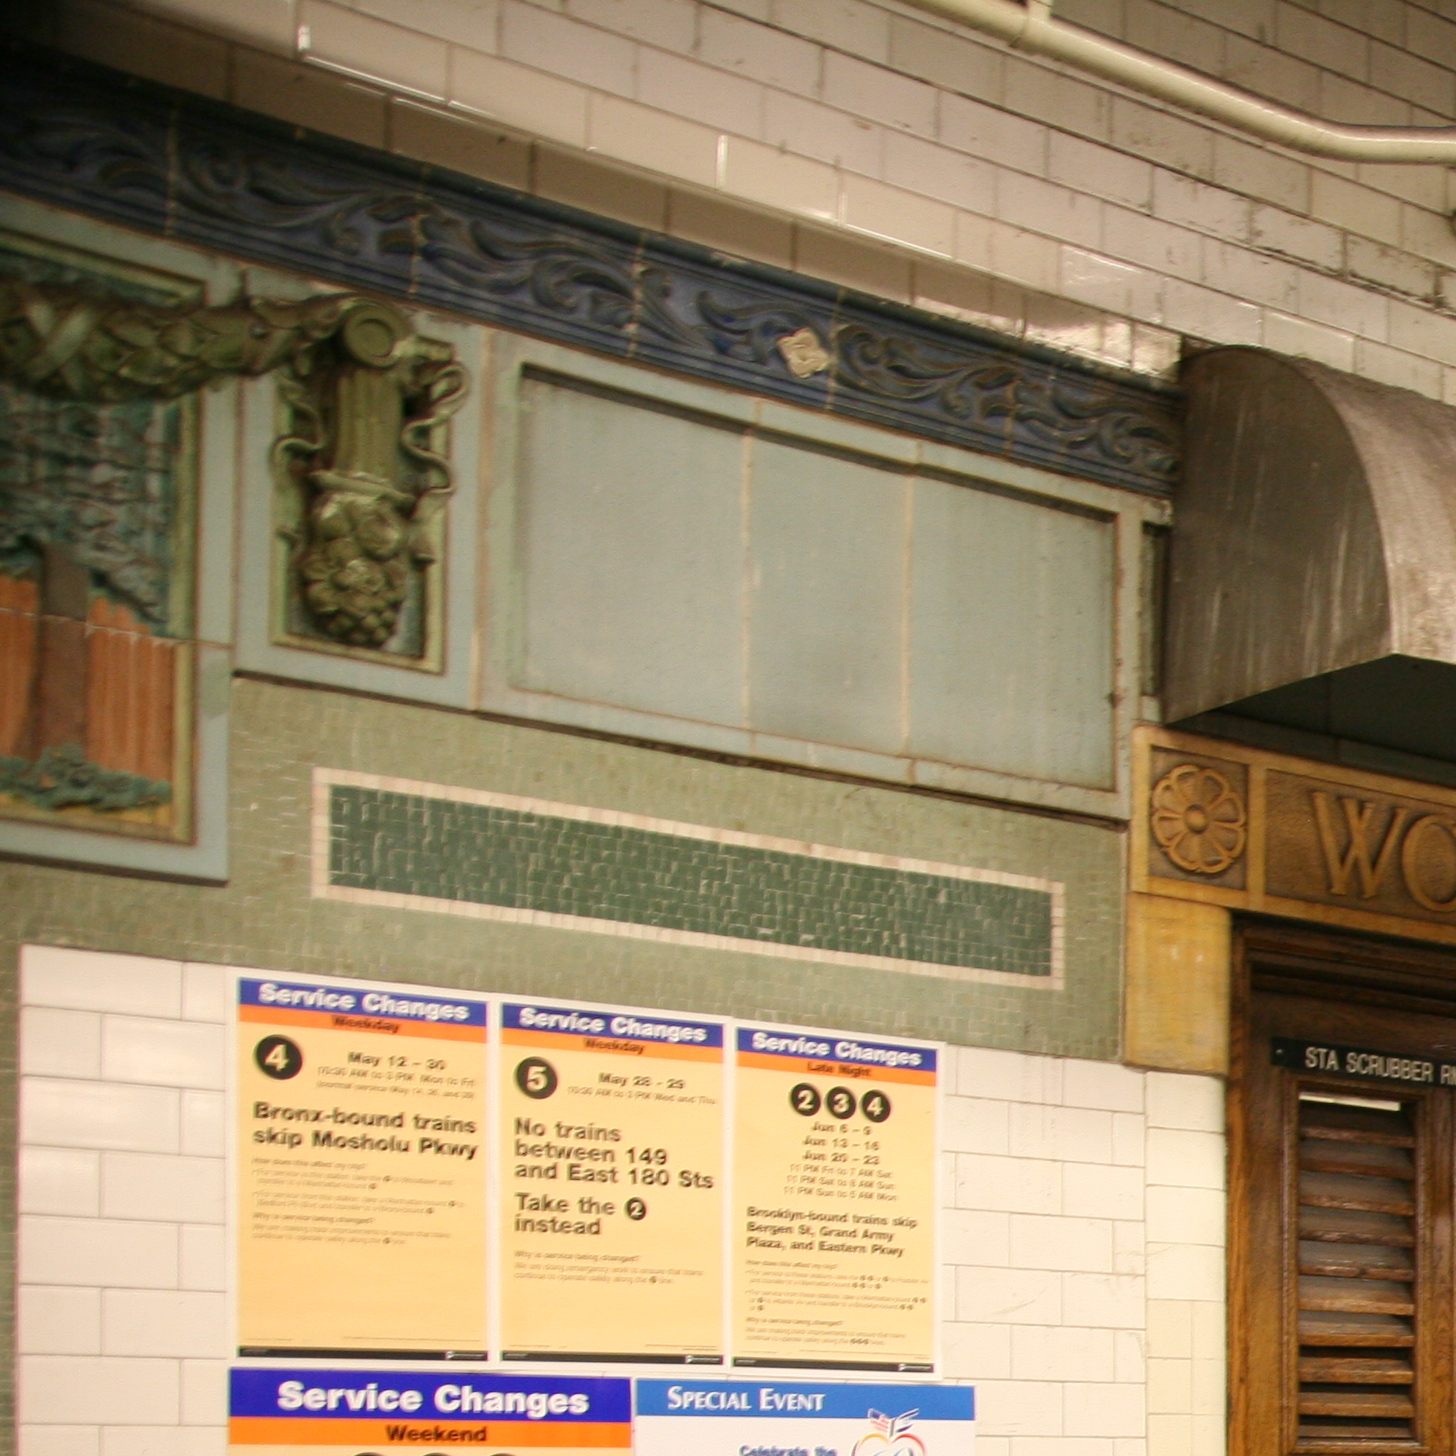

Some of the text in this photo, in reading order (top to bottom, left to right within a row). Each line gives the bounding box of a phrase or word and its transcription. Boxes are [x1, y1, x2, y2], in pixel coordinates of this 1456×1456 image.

[258, 983, 470, 1021] Service Changes
[331, 1015, 400, 1034] Weekday
[519, 1007, 707, 1043] Service Changes
[264, 1043, 289, 1072] 4
[583, 1038, 646, 1055] Weekday
[752, 1032, 922, 1066] Service Changes
[348, 1051, 380, 1068] May
[806, 1061, 872, 1078] Late Night
[1306, 1047, 1338, 1071] STA
[1348, 1052, 1433, 1083] SCRUBBER
[526, 1065, 548, 1092] 5
[599, 1072, 628, 1087] May
[798, 1089, 883, 1117] 2 3 4
[254, 1101, 477, 1134] Bronx-bound trains
[514, 1117, 622, 1142] No trains
[811, 1121, 835, 1132] Jun
[254, 1127, 478, 1160] skip Mosholu Pkwy
[514, 1138, 668, 1165] between 149
[802, 1136, 826, 1147] Jun
[802, 1151, 826, 1162] Jun
[514, 1161, 714, 1189] and East 180 Sts
[514, 1192, 570, 1214] Take
[579, 1196, 616, 1216] the
[514, 1213, 601, 1235] instead
[747, 1206, 917, 1230] Brooklyn-bound trains skip
[746, 1221, 793, 1235] Bergen
[819, 1226, 858, 1239] Grand
[862, 1228, 894, 1243] Army
[790, 1241, 814, 1250] and
[819, 1240, 867, 1253] Eastern
[871, 1244, 904, 1258] Pkwy
[277, 1380, 589, 1420] Service Changes
[667, 1385, 825, 1412] SPECIAL EVENT
[386, 1423, 487, 1442] Weekend
